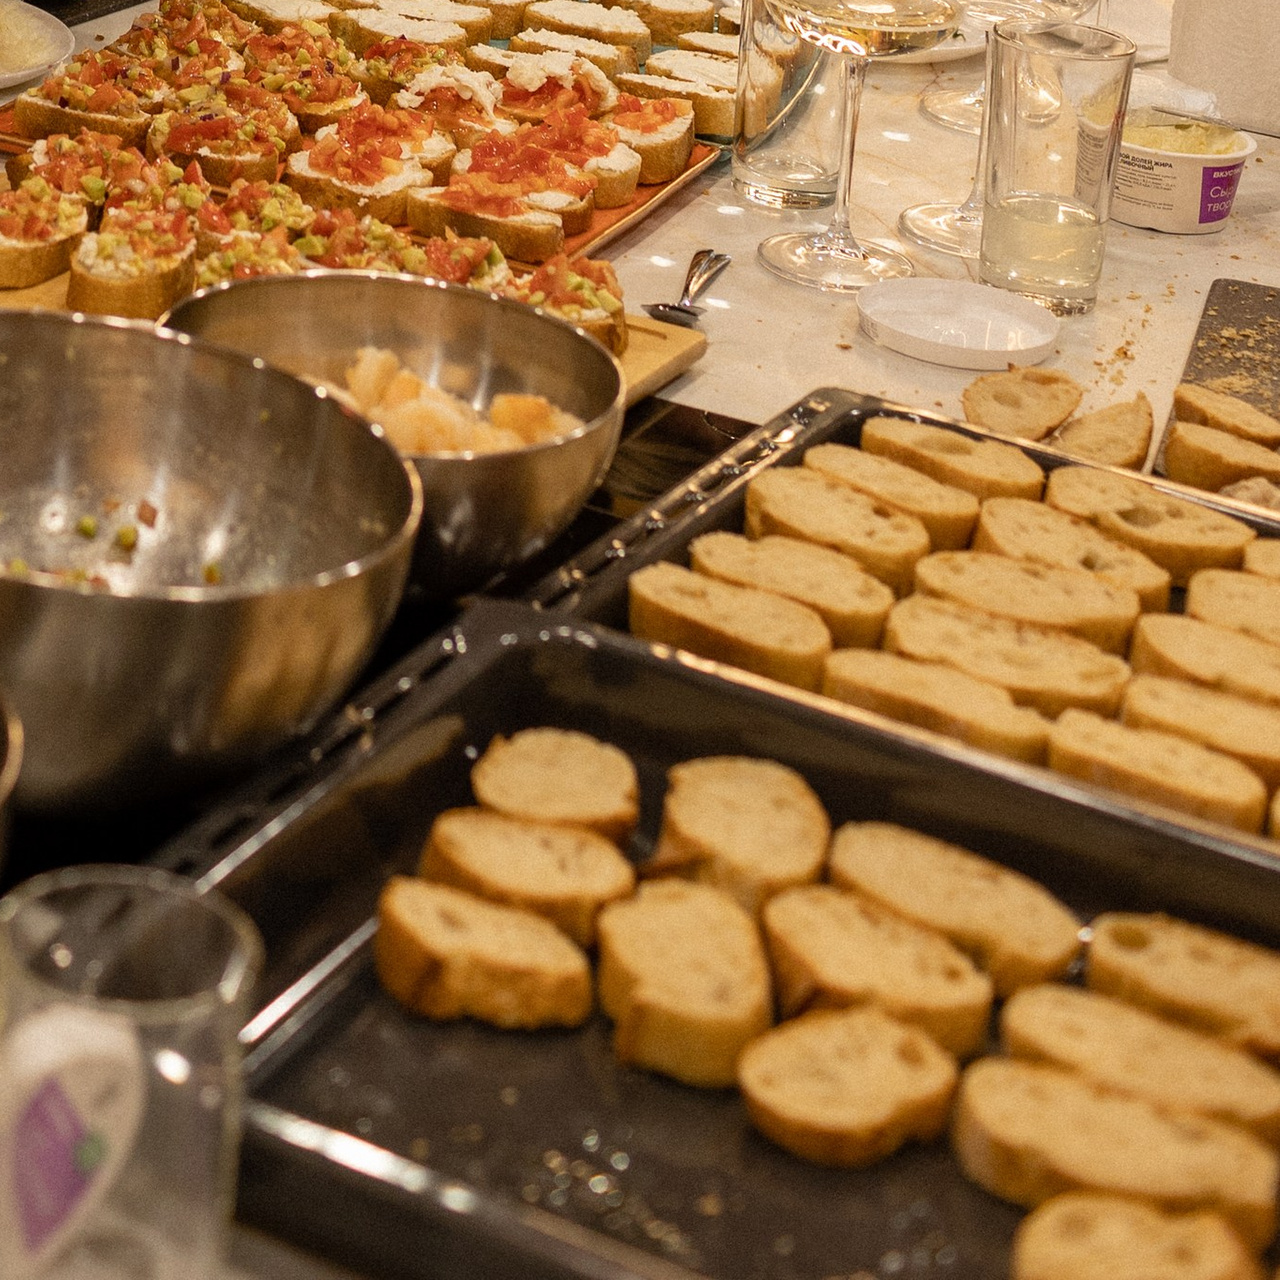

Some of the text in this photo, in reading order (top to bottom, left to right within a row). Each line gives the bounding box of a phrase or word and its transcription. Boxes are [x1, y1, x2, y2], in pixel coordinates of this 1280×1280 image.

[1119, 158, 1155, 171] ЛИВОЧНЫЙ
[1131, 154, 1153, 165] ДОЛЕЙ
[1153, 159, 1173, 169] ЖИРА
